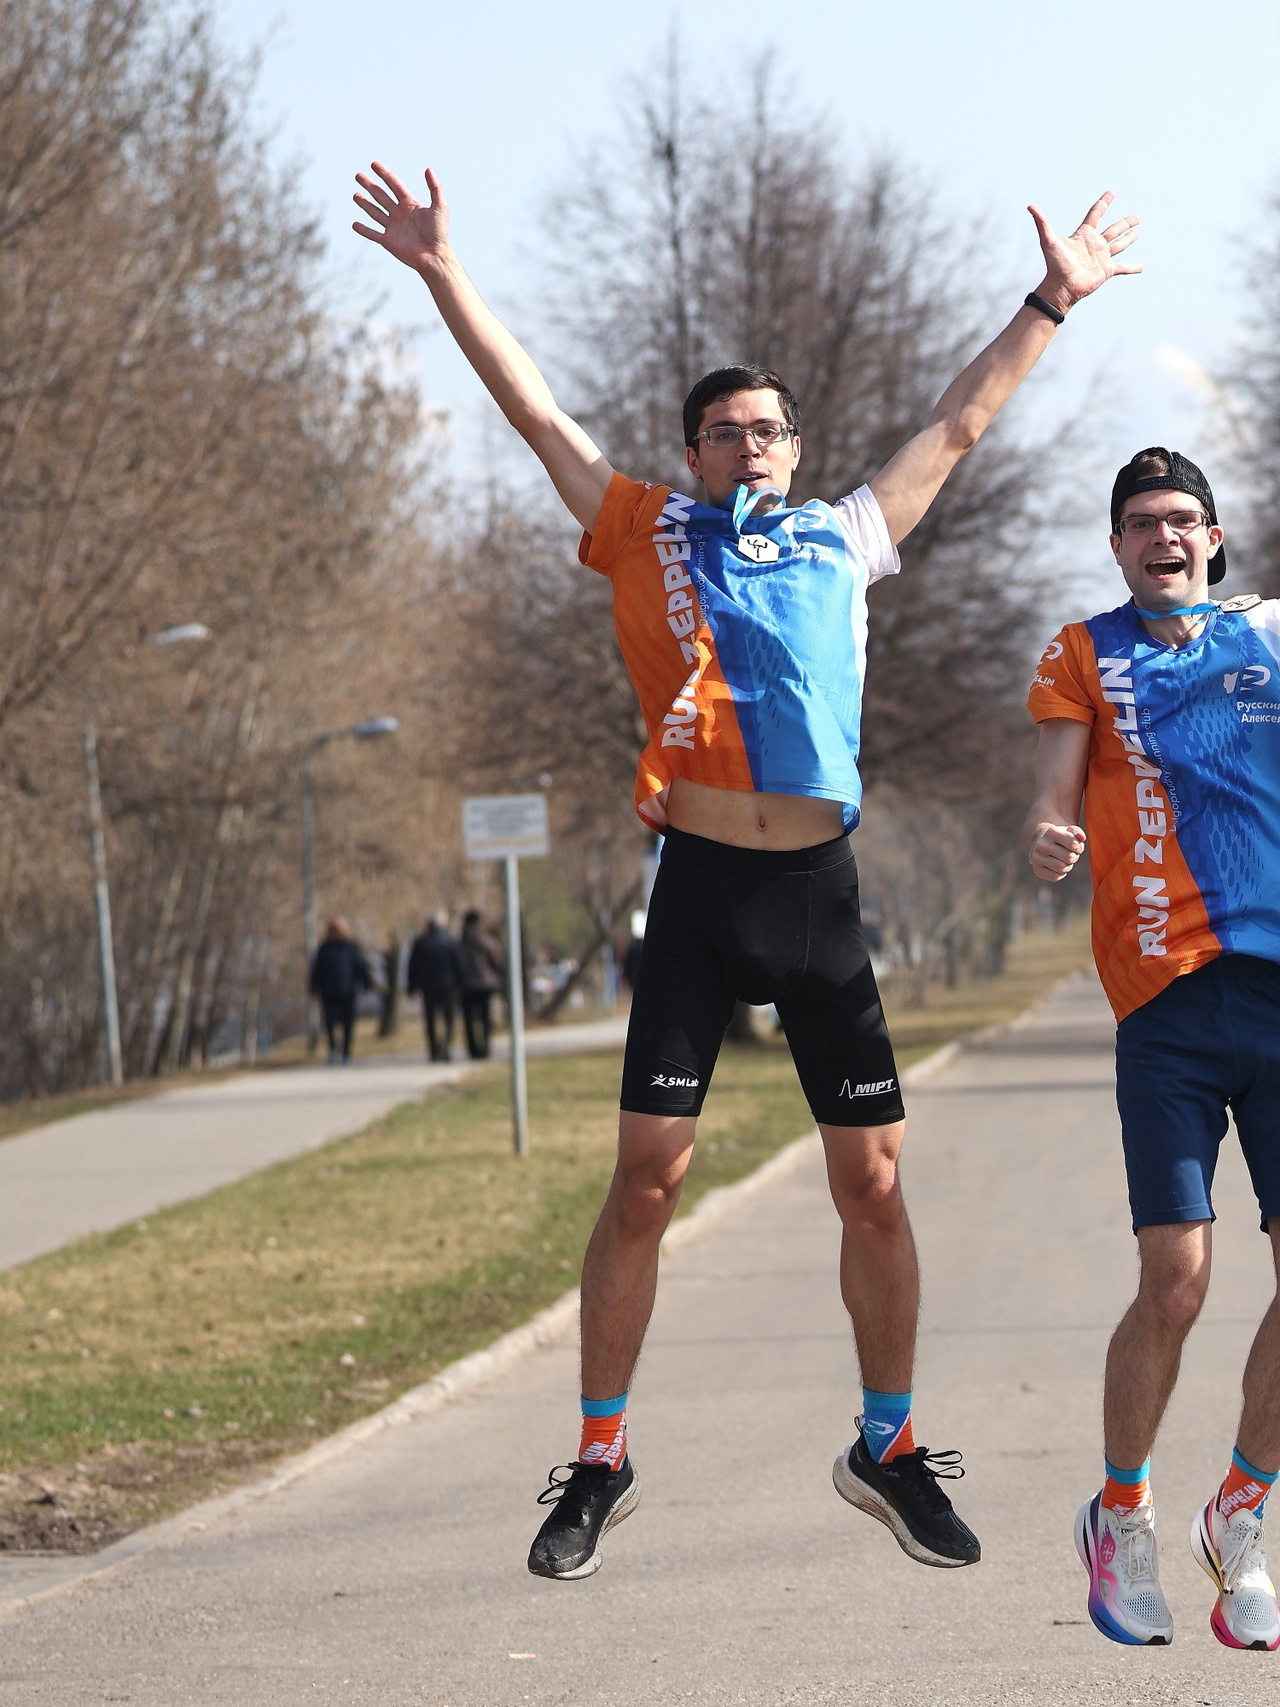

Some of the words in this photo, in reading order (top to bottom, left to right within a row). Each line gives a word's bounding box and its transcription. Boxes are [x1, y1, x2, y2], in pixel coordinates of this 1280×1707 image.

[1098, 658, 1167, 865] ZEPPELIN
[1132, 875, 1170, 957] RUN
[855, 1079, 894, 1094] MIPT
